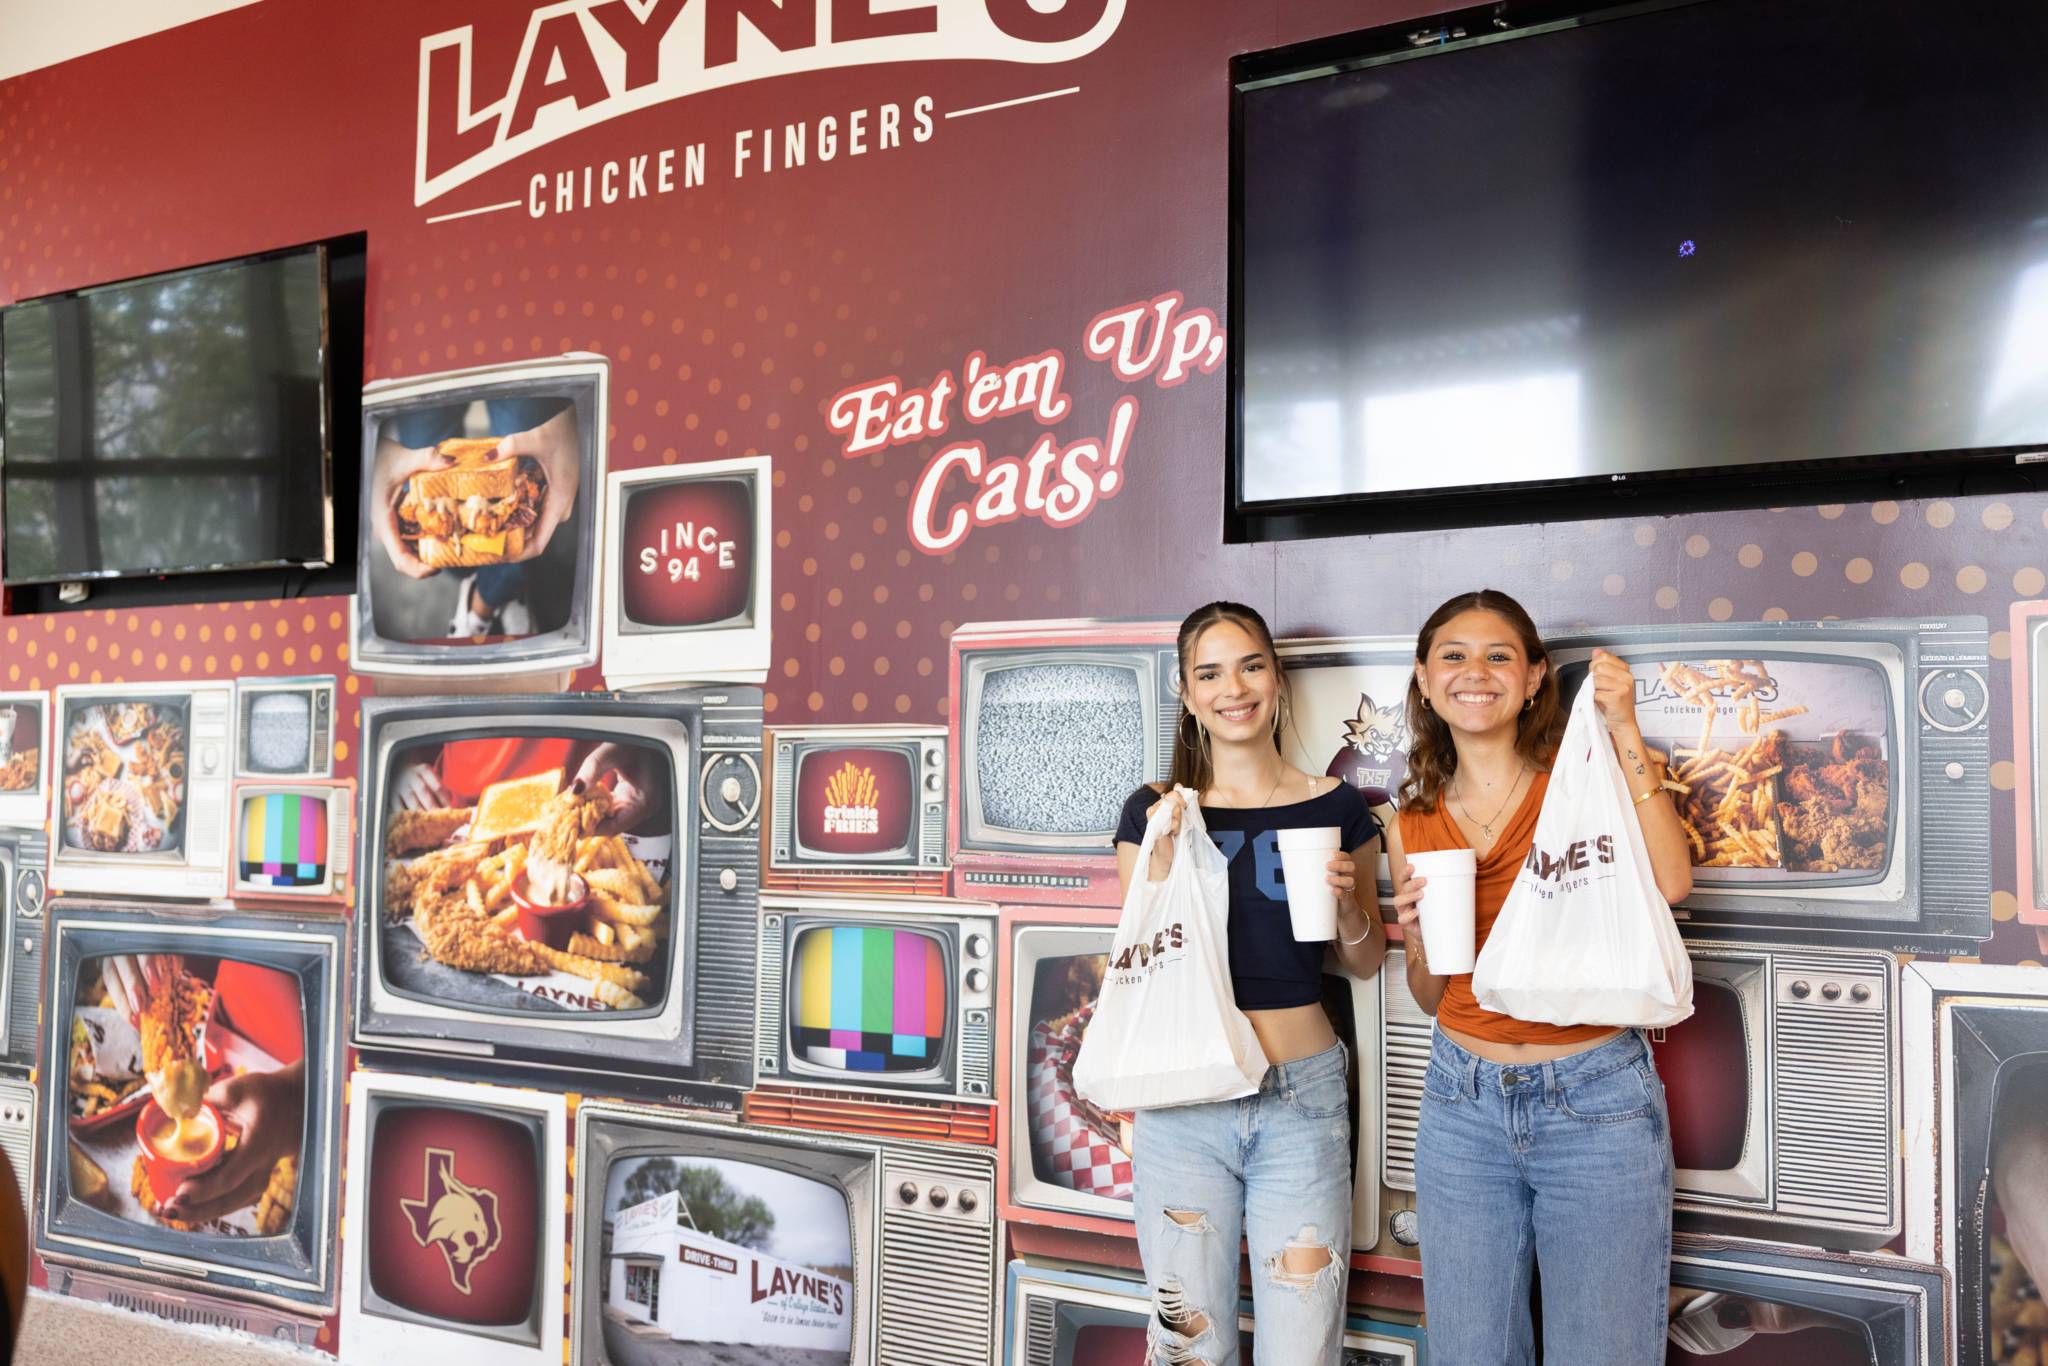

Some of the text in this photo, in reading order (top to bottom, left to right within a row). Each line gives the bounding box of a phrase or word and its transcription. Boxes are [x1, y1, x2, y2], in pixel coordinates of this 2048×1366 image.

[415, 0, 1128, 207] LAYN
[528, 95, 935, 219] CHICKEN FINGERS
[829, 297, 1225, 454] Eat 'em Up,
[911, 399, 1135, 550] Cats!
[640, 521, 736, 574] SINCE
[667, 556, 700, 583] 94
[1357, 767, 1391, 788] TXST
[824, 819, 879, 834] FRIES
[751, 1259, 843, 1316] LAYNE'S
